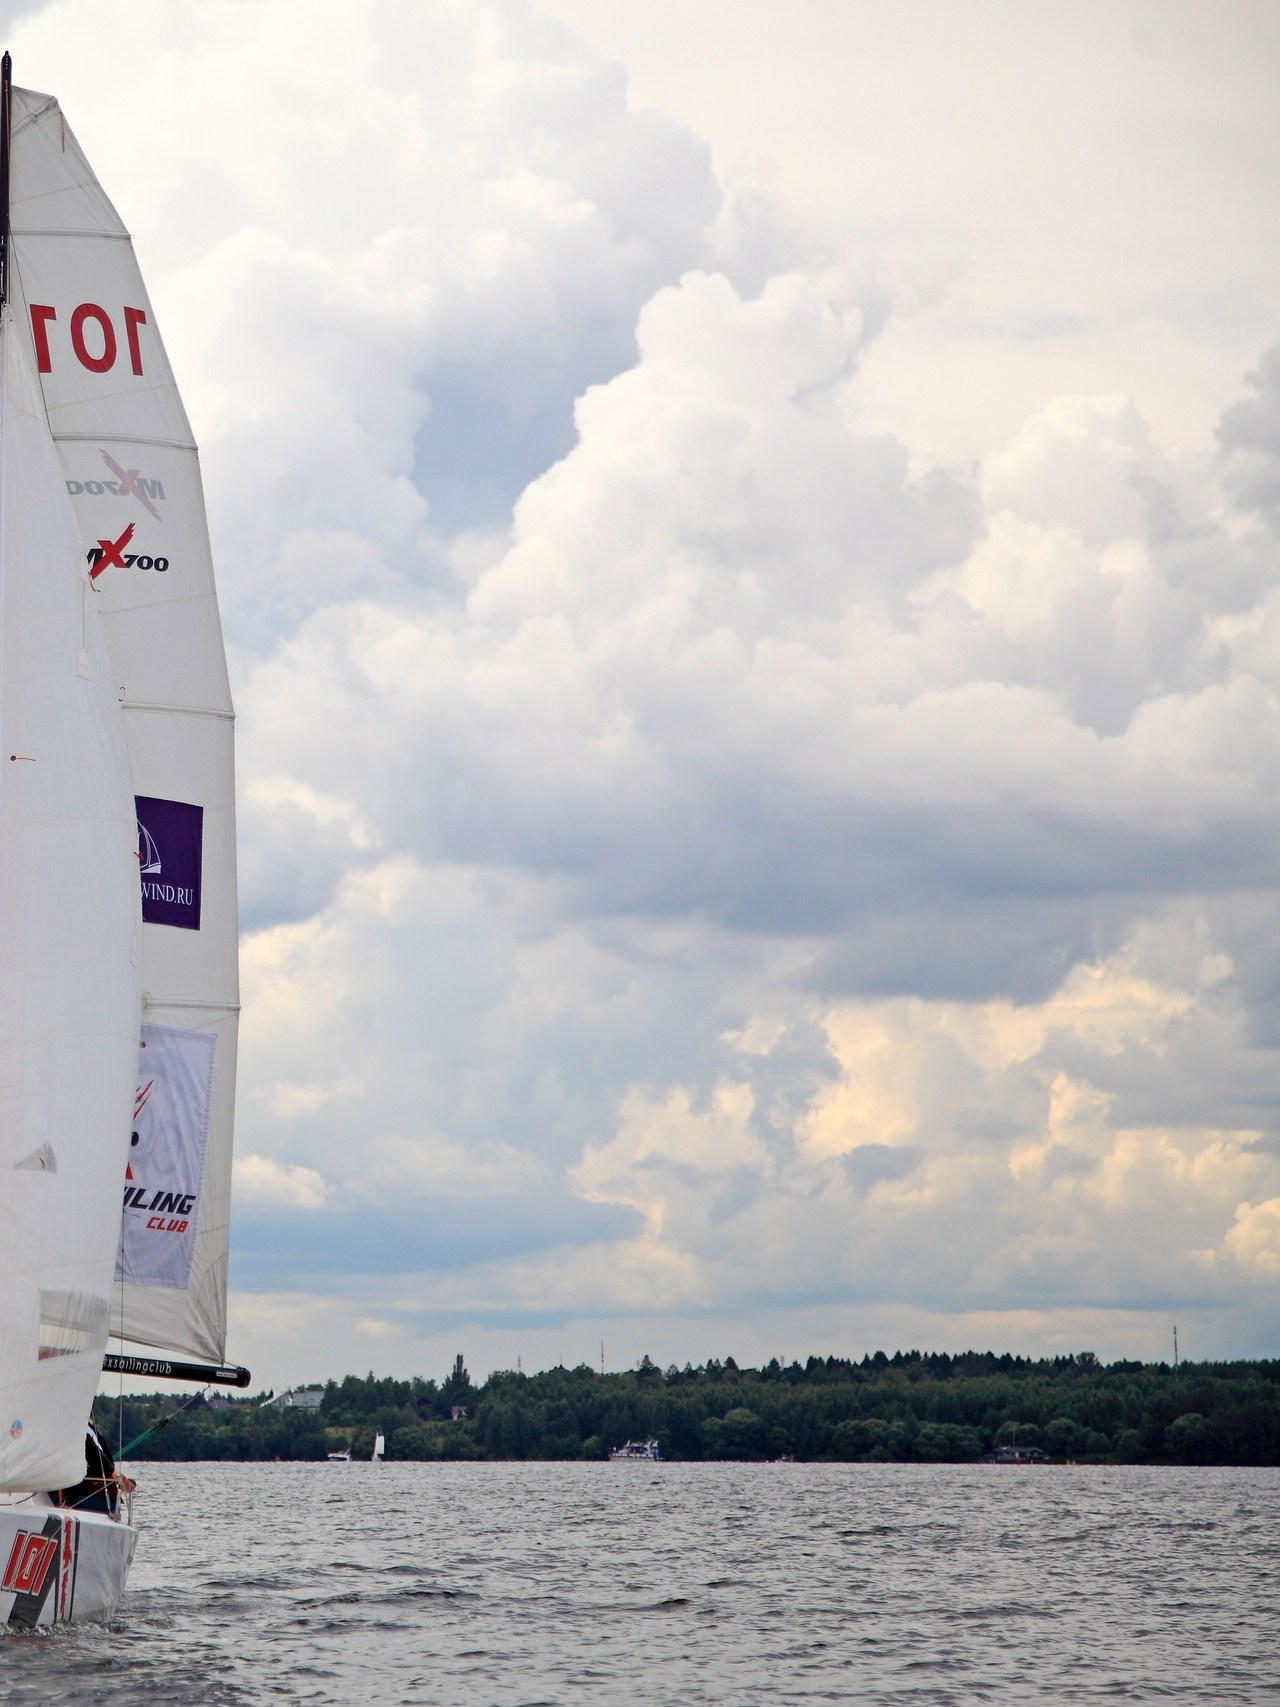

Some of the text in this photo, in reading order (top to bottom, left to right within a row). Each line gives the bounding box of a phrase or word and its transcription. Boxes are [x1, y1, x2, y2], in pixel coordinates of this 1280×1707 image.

[123, 1186, 196, 1215] ILING
[146, 1217, 188, 1233] CLUB
[1, 1529, 59, 1597] 101
